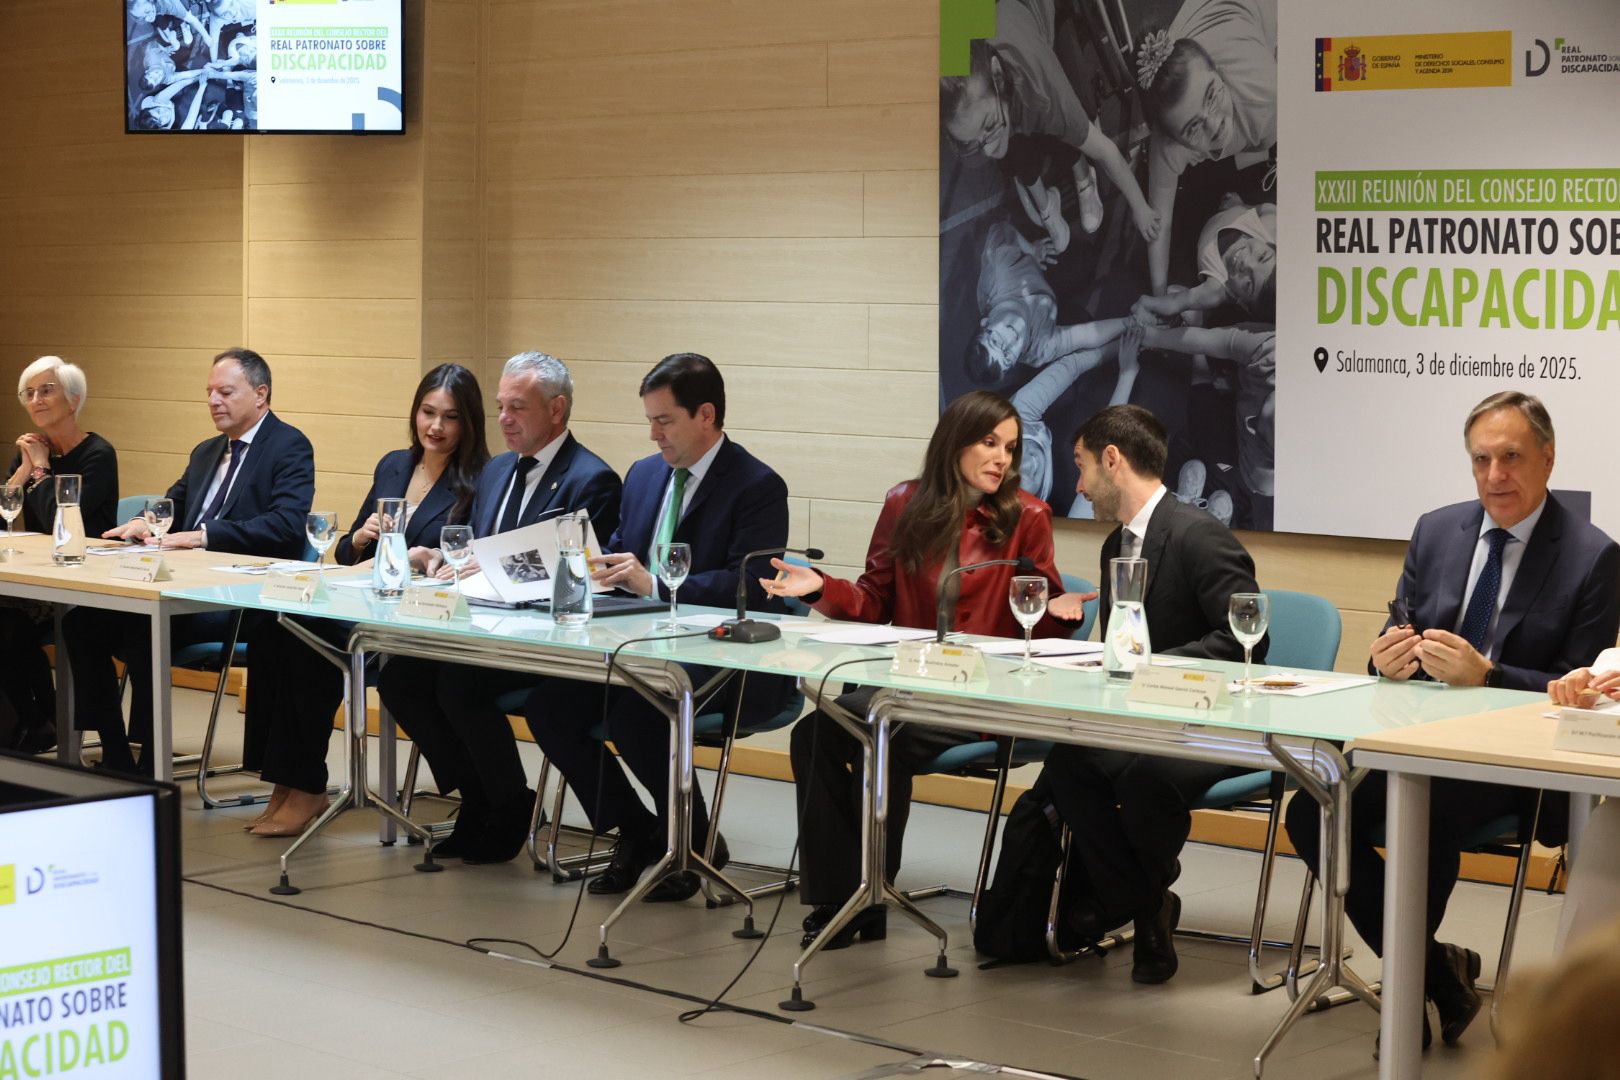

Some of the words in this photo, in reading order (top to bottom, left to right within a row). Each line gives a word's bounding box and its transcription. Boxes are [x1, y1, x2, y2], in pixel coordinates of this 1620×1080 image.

[270, 40, 293, 50] REAL
[295, 40, 353, 50] PATRONATO
[355, 40, 386, 50] SOBRE
[1561, 55, 1607, 63] PATRONATO
[271, 53, 387, 70] DISCAPACIDAD
[1561, 64, 1620, 73] DISCAPACIDA
[1318, 179, 1356, 204] XXXII
[1363, 171, 1438, 204] REUNIÓN
[1443, 178, 1475, 204] DEL
[1480, 178, 1557, 203] CONSEJO
[1563, 177, 1620, 203] RECTO
[1316, 217, 1380, 254] REAL
[1389, 217, 1559, 255] PATRONATO
[1336, 350, 1411, 378] Salamanca,
[1416, 352, 1424, 375] 3
[1430, 352, 1445, 376] de
[1449, 352, 1514, 378] diciembre
[1518, 354, 1535, 378] de
[1539, 355, 1582, 380] 2025.
[54, 957, 103, 983] RECTOR
[105, 952, 130, 973] DEL
[61, 981, 128, 1018] SOBRE
[0, 1019, 130, 1080] ACIDAD
